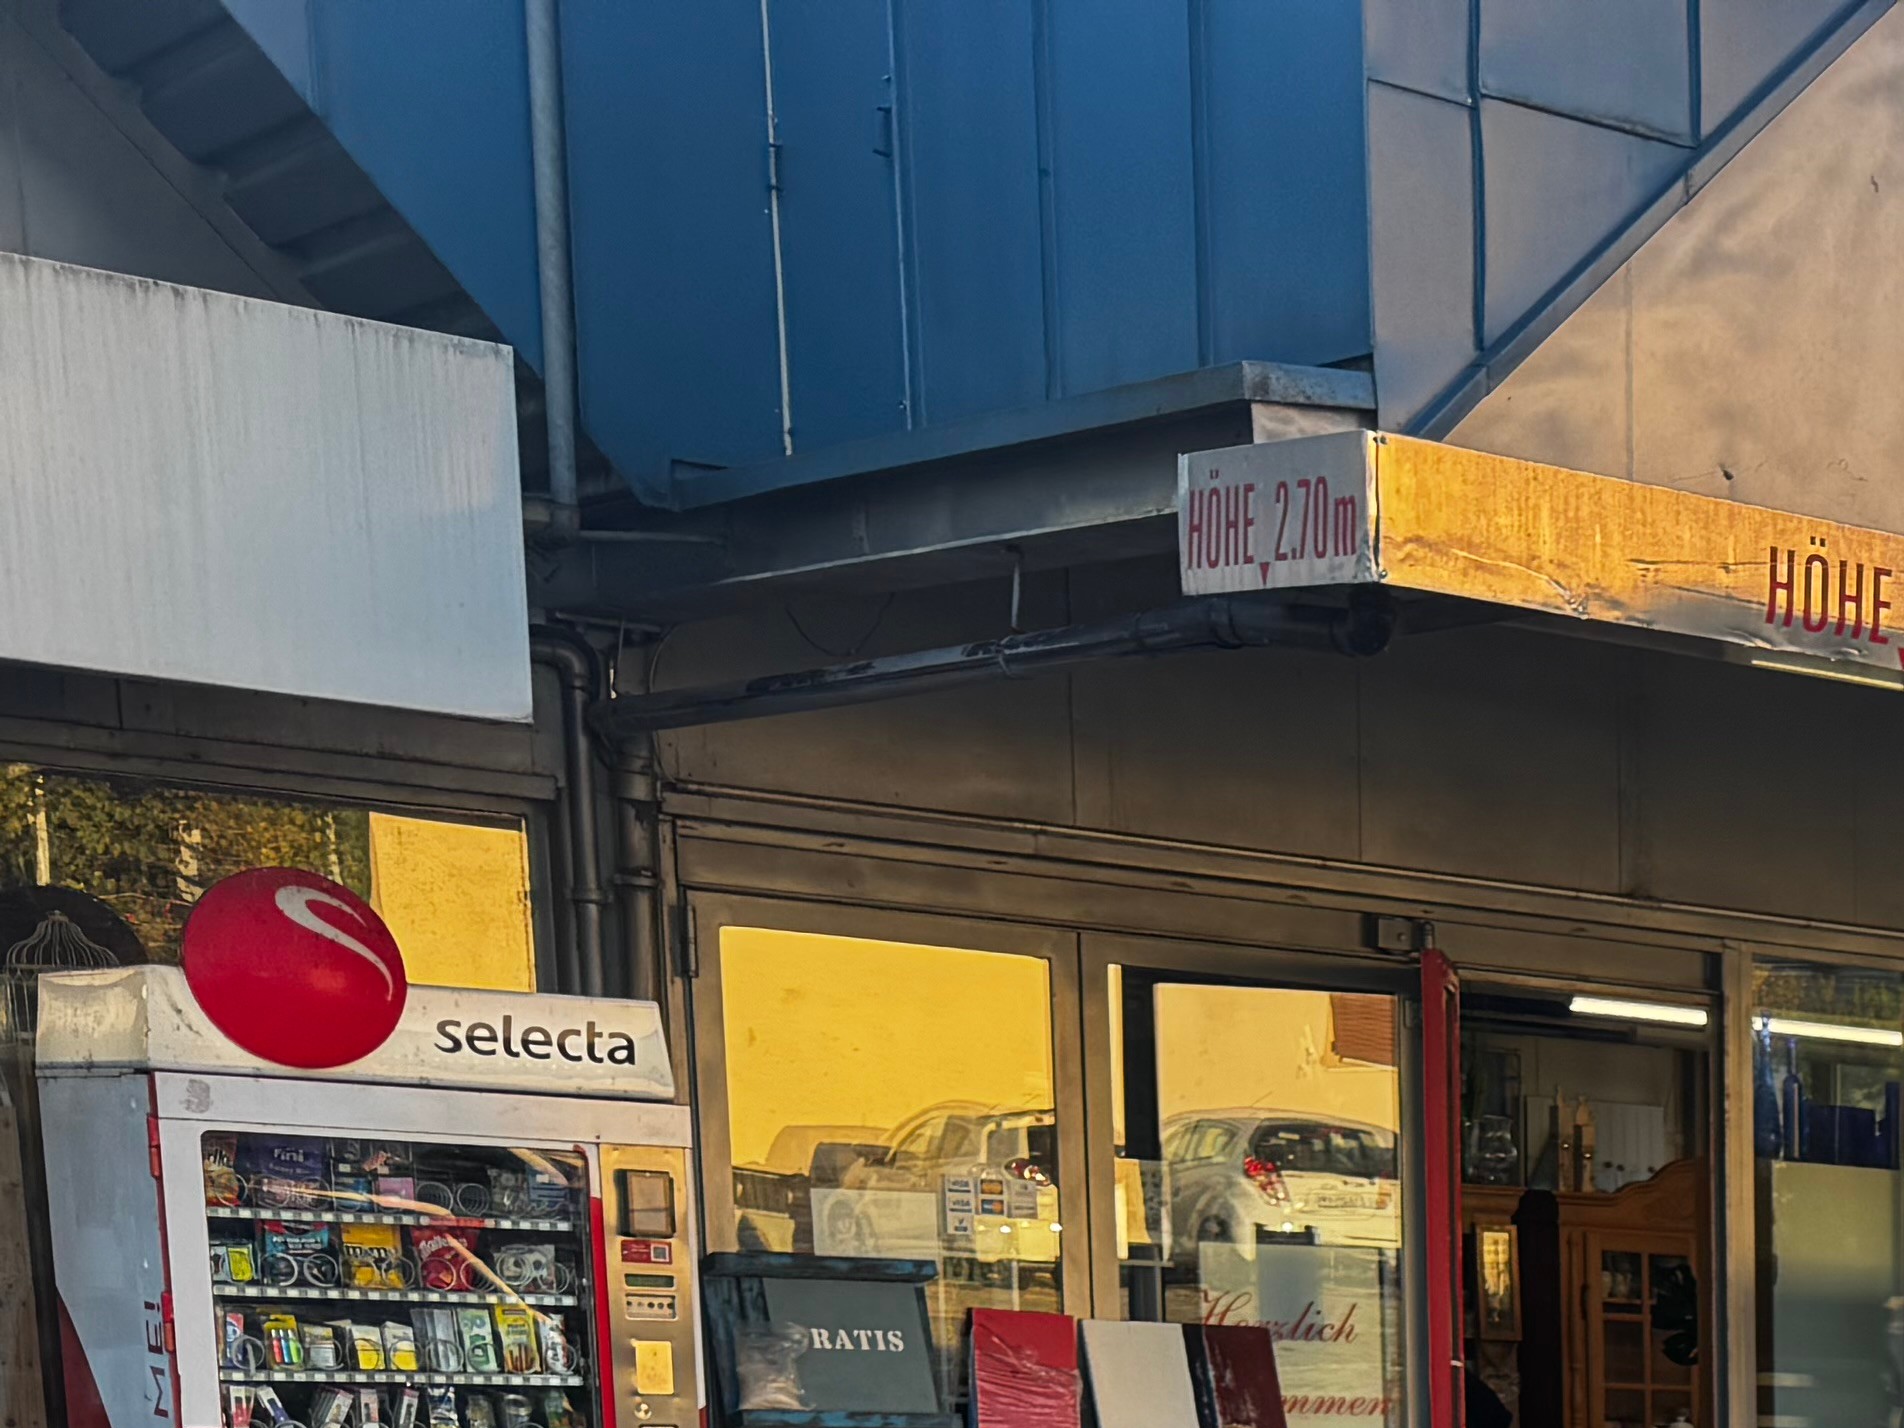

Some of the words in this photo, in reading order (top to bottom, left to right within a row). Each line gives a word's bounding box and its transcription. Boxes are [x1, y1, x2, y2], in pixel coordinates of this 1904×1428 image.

[1186, 468, 1257, 569] HÖHE
[1764, 535, 1893, 645] HÖHE
[434, 1013, 637, 1066] selecta
[804, 1328, 905, 1352] RATIS
